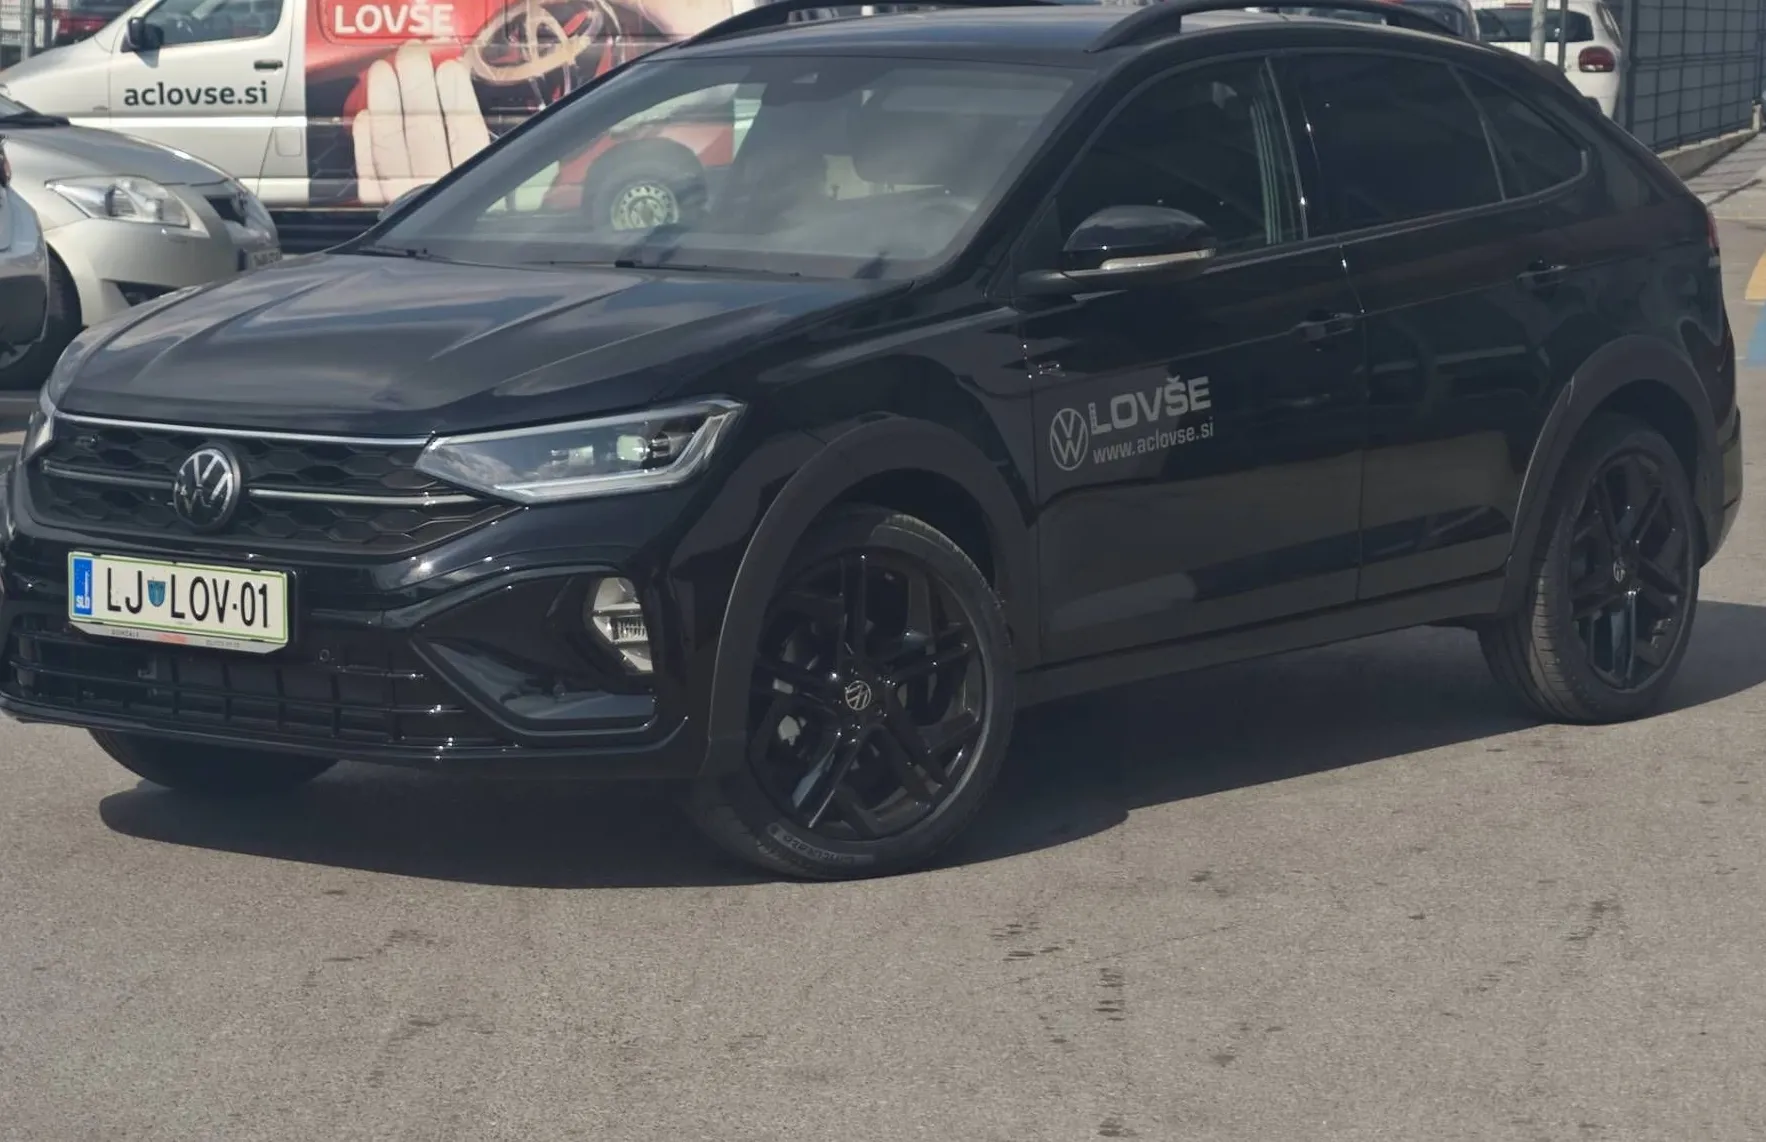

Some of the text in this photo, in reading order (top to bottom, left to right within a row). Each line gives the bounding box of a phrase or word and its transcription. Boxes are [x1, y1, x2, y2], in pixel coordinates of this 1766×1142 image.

[335, 0, 454, 36] LOVŠE
[124, 81, 268, 106] aclovse.si
[1088, 375, 1212, 436] LOVŠE
[1093, 416, 1214, 464] www.aclovse.si
[107, 567, 143, 614] LJ
